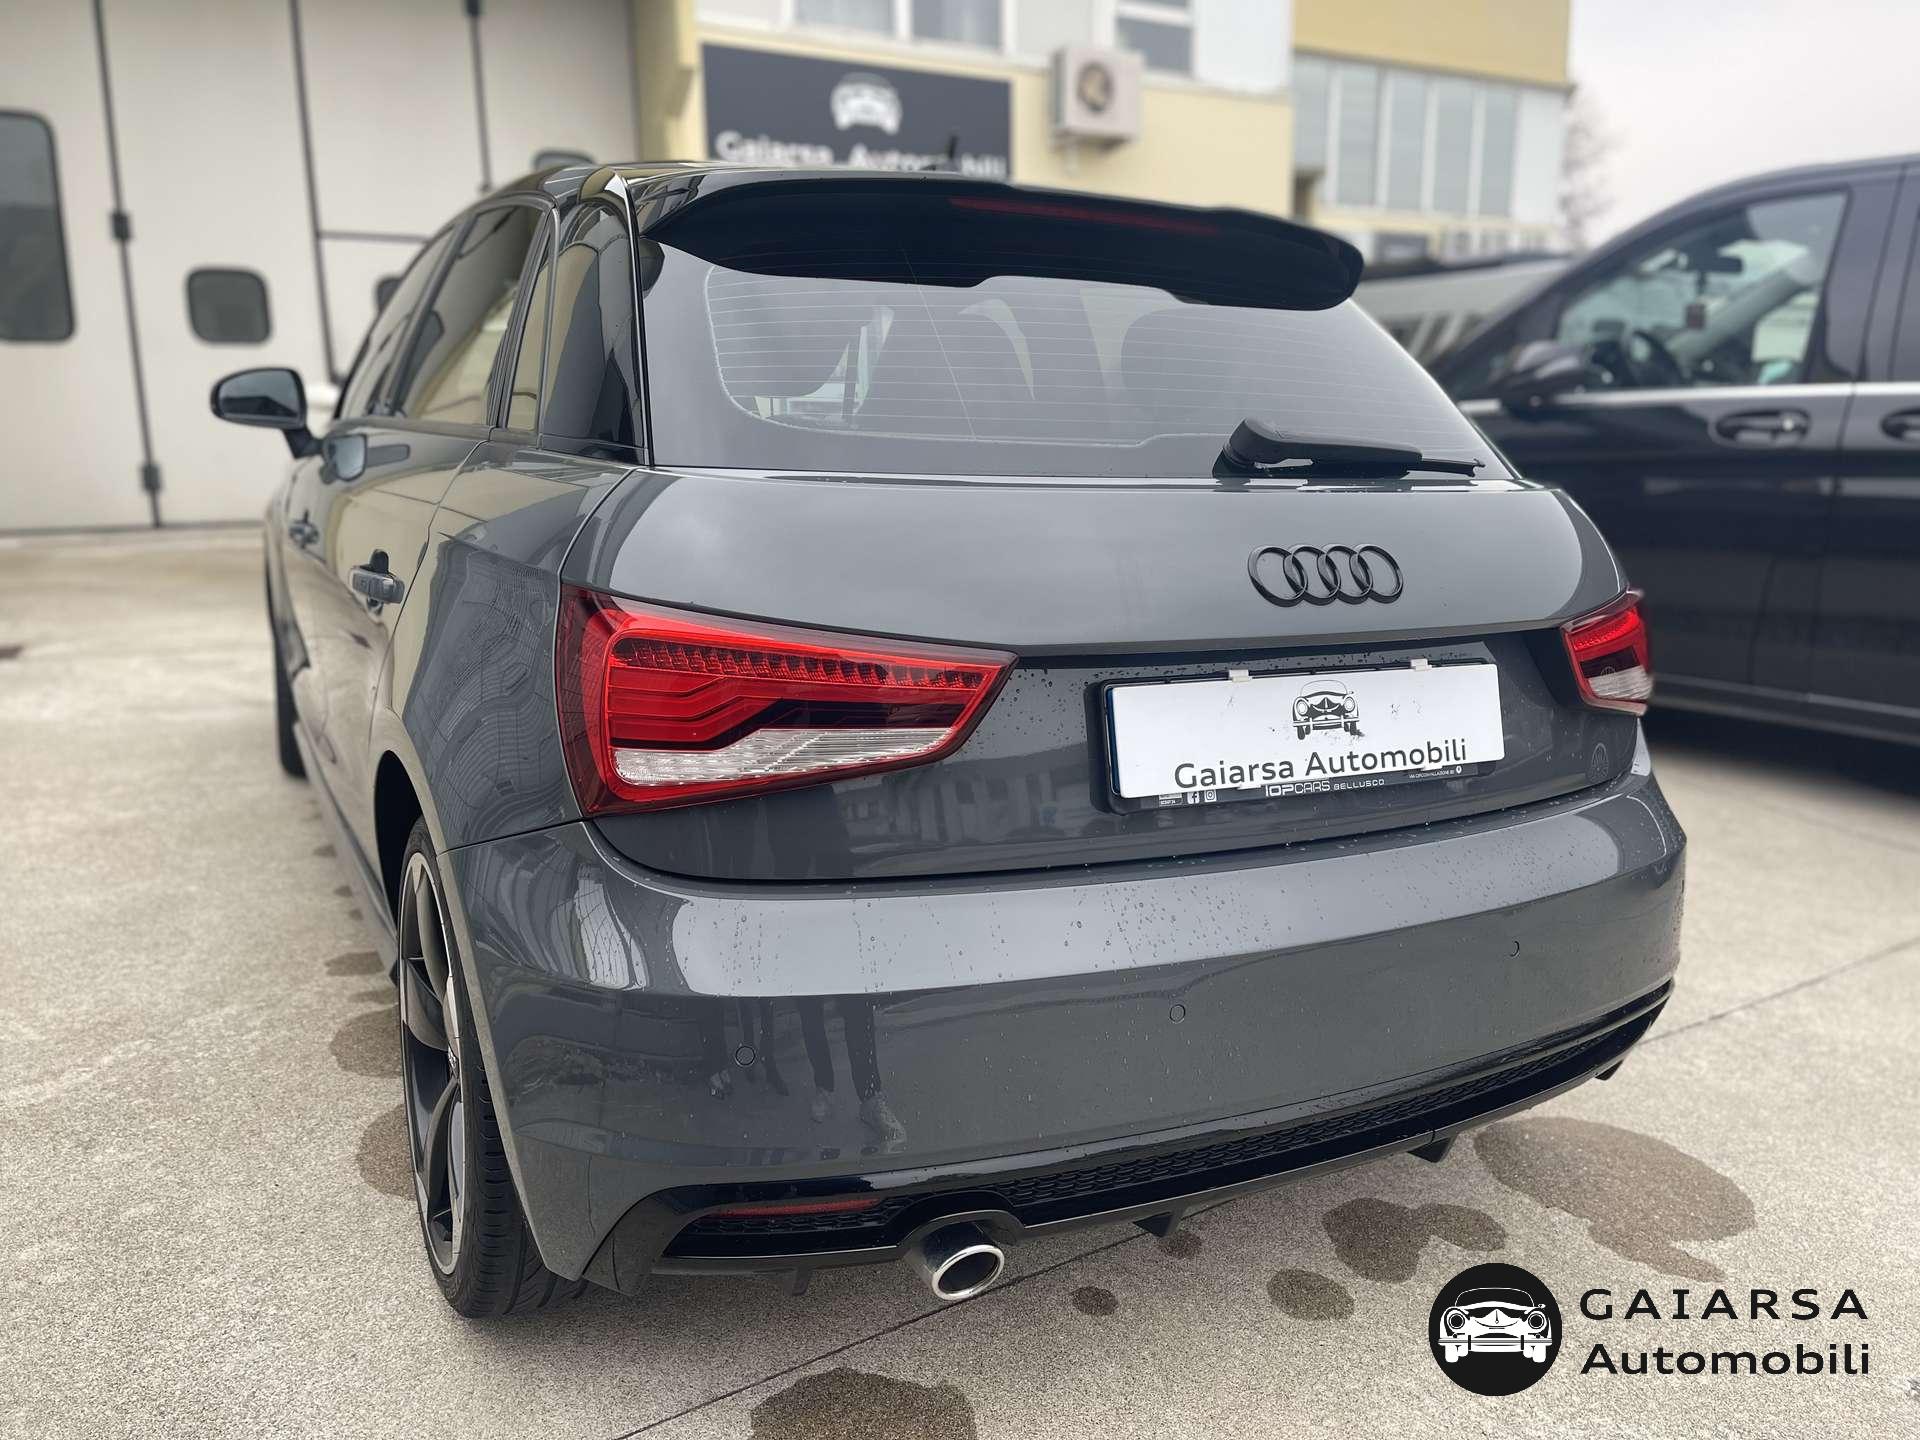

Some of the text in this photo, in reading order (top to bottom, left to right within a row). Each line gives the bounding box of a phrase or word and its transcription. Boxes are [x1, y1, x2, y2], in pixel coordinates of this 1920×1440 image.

[1174, 738, 1467, 788] Gaiarsa Automobili
[1333, 778, 1385, 791] BELLUSCO
